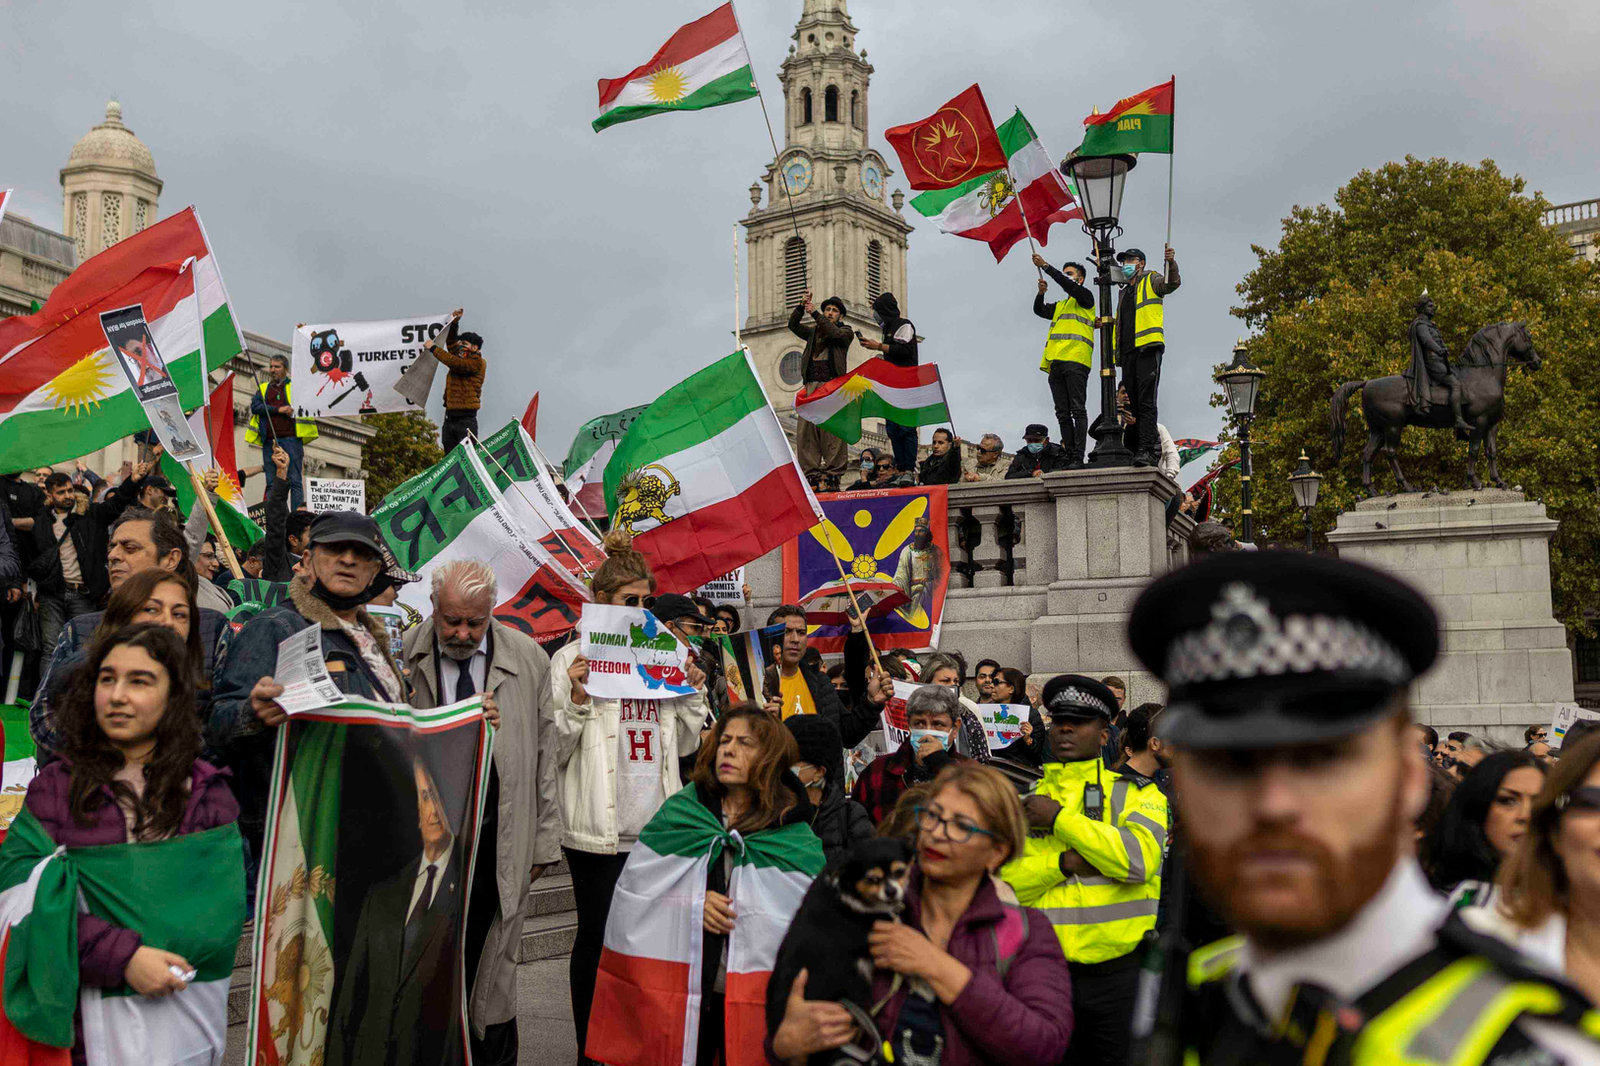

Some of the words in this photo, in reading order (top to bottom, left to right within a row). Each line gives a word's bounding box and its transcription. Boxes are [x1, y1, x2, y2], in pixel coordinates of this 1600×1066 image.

[107, 324, 119, 333] IRAN
[401, 323, 447, 344] STO
[357, 349, 416, 362] TURKEY'S
[345, 488, 362, 497] PEOPLE
[311, 494, 319, 502] DO
[319, 494, 331, 502] NOT
[332, 495, 350, 503] WANT
[350, 496, 360, 504] AN
[314, 503, 343, 511] ISLAMIC
[700, 591, 715, 599] WAR
[716, 591, 741, 599] CRIMES
[589, 632, 628, 647] WOMAN
[588, 660, 631, 675] FREEDOM
[620, 699, 661, 723] RVA
[627, 730, 653, 762] H
[1140, 802, 1166, 812] POLIC
